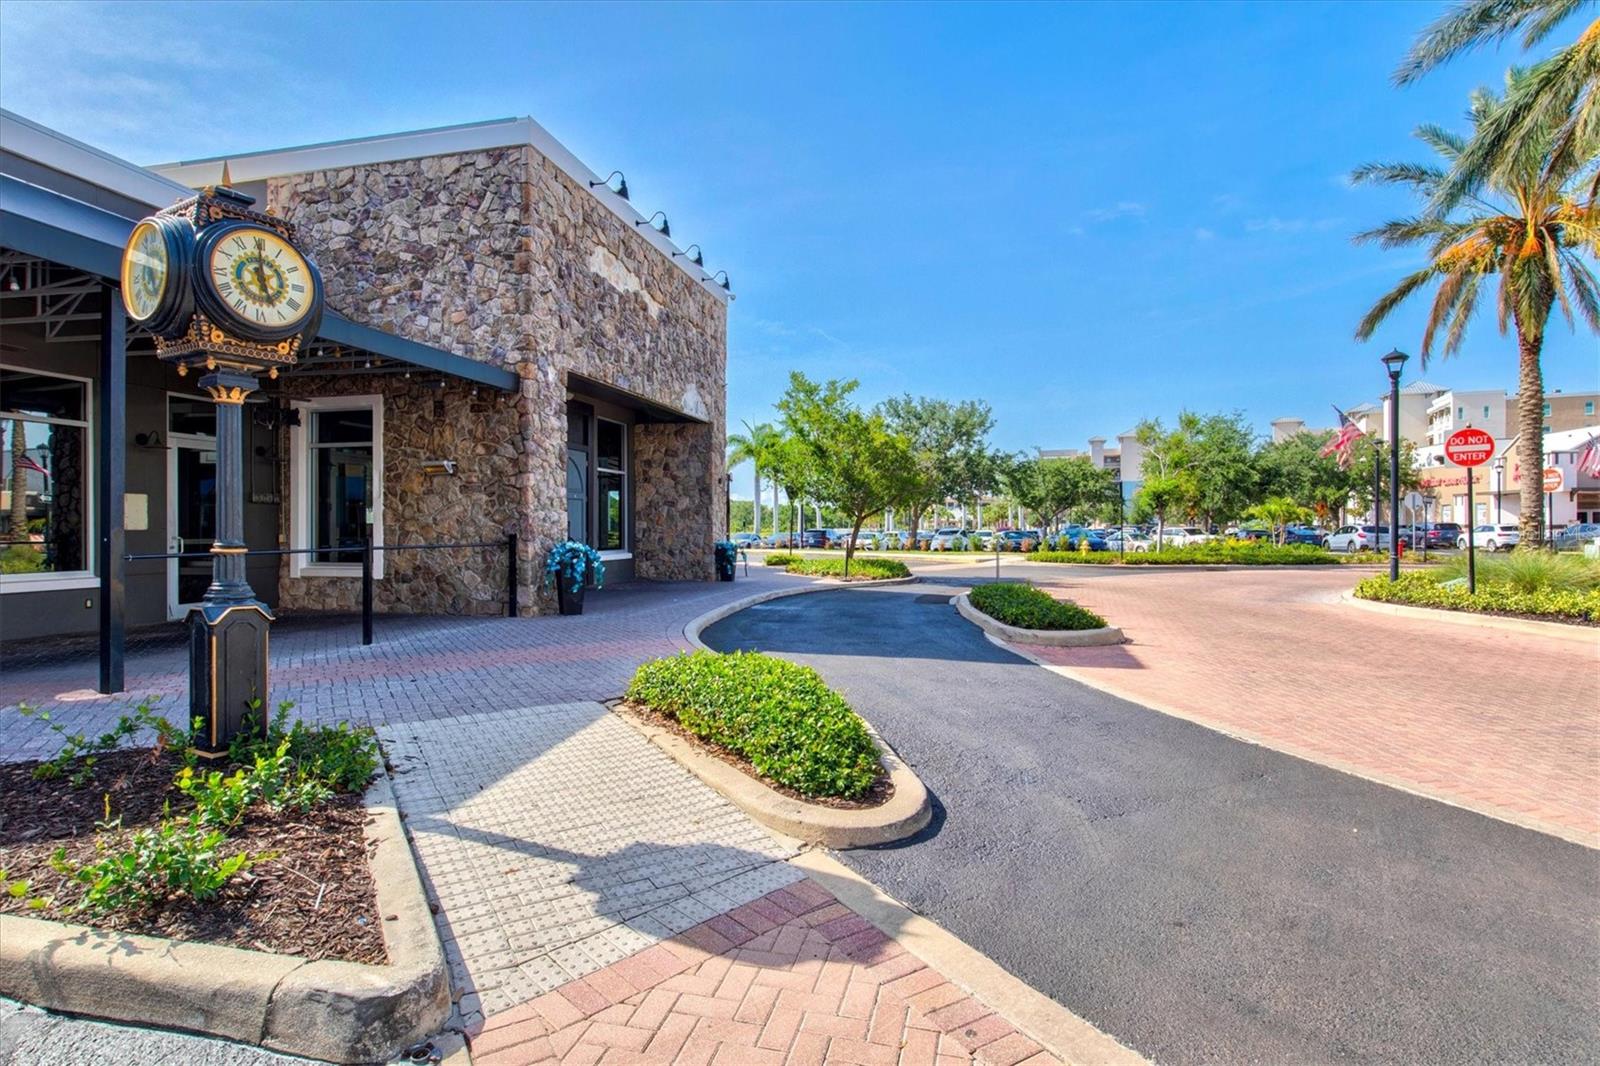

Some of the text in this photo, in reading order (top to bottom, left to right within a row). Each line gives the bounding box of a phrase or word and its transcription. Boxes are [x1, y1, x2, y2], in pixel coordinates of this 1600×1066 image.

[232, 236, 247, 250] XI
[216, 246, 233, 260] X
[275, 249, 282, 258] I
[214, 265, 228, 277] IX
[286, 266, 299, 274] II
[218, 281, 233, 298] VIII
[233, 298, 247, 315] VII
[255, 308, 267, 323] VI
[277, 310, 286, 321] V
[1450, 435, 1489, 445] DO NOT
[1453, 452, 1486, 461] ENTER
